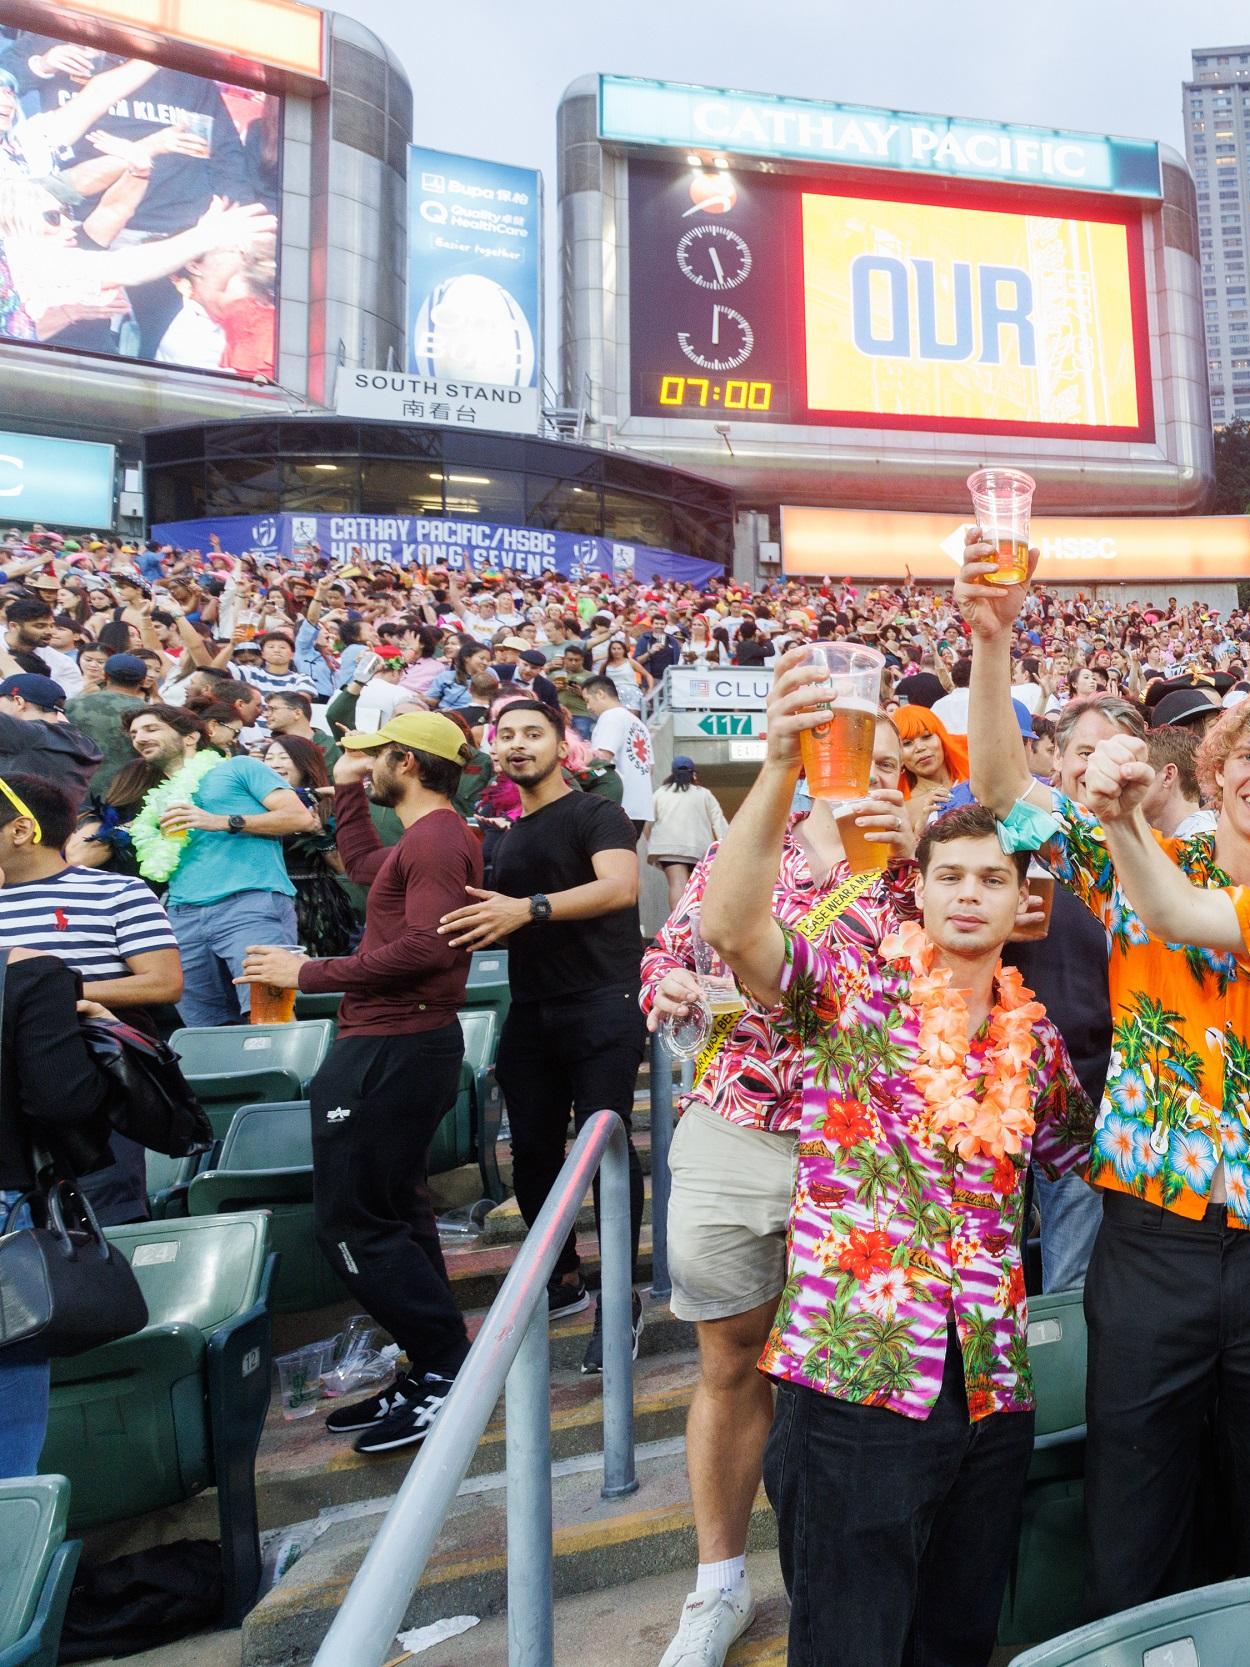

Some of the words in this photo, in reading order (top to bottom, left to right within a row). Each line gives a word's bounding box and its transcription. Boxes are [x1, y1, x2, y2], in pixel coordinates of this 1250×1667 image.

[692, 102, 899, 157] CATHAY
[910, 126, 1088, 178] PACIFIC
[447, 179, 495, 200] Bupa
[451, 204, 502, 223] Quality
[451, 215, 529, 238] HealthCare
[851, 253, 1038, 368] OUR
[355, 373, 438, 396] SOUTH
[445, 384, 522, 404] STAND
[659, 375, 772, 411] 07:00
[402, 399, 477, 424] 南看台
[330, 517, 410, 541] CATHAY
[416, 520, 557, 555] PACIFIC/HSBC
[1041, 536, 1118, 560] HSBC
[330, 541, 392, 565] HONG
[402, 543, 463, 567] KONG
[473, 547, 557, 576] SEVENS
[715, 681, 769, 698] CLU
[706, 715, 750, 735] 117
[801, 909, 830, 937] LEASE
[825, 888, 851, 912] WEAR
[849, 883, 859, 892] A
[708, 1030, 720, 1056] MASK
